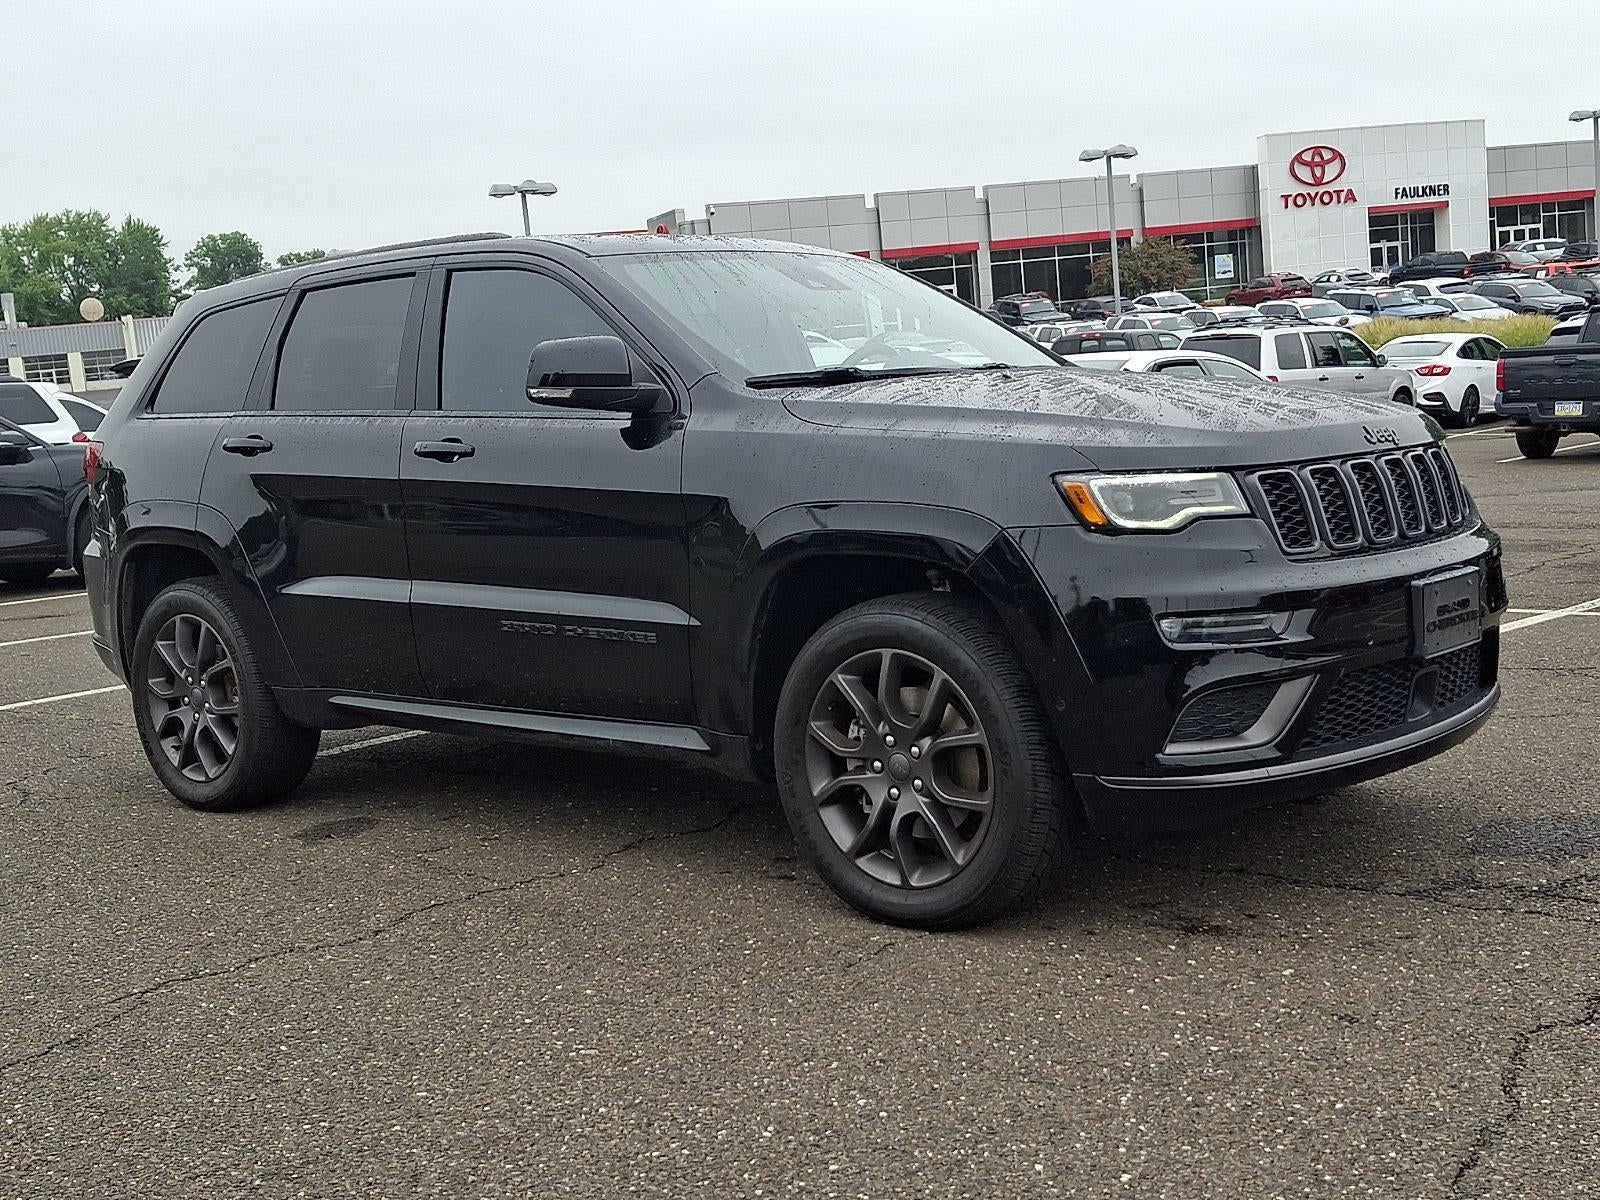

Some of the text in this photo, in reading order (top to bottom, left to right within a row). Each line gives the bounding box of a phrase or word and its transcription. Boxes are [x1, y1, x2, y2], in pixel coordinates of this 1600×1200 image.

[1280, 188, 1358, 210] TOYOTA
[1394, 184, 1450, 200] FAULKNER
[1361, 425, 1400, 447] Jeep
